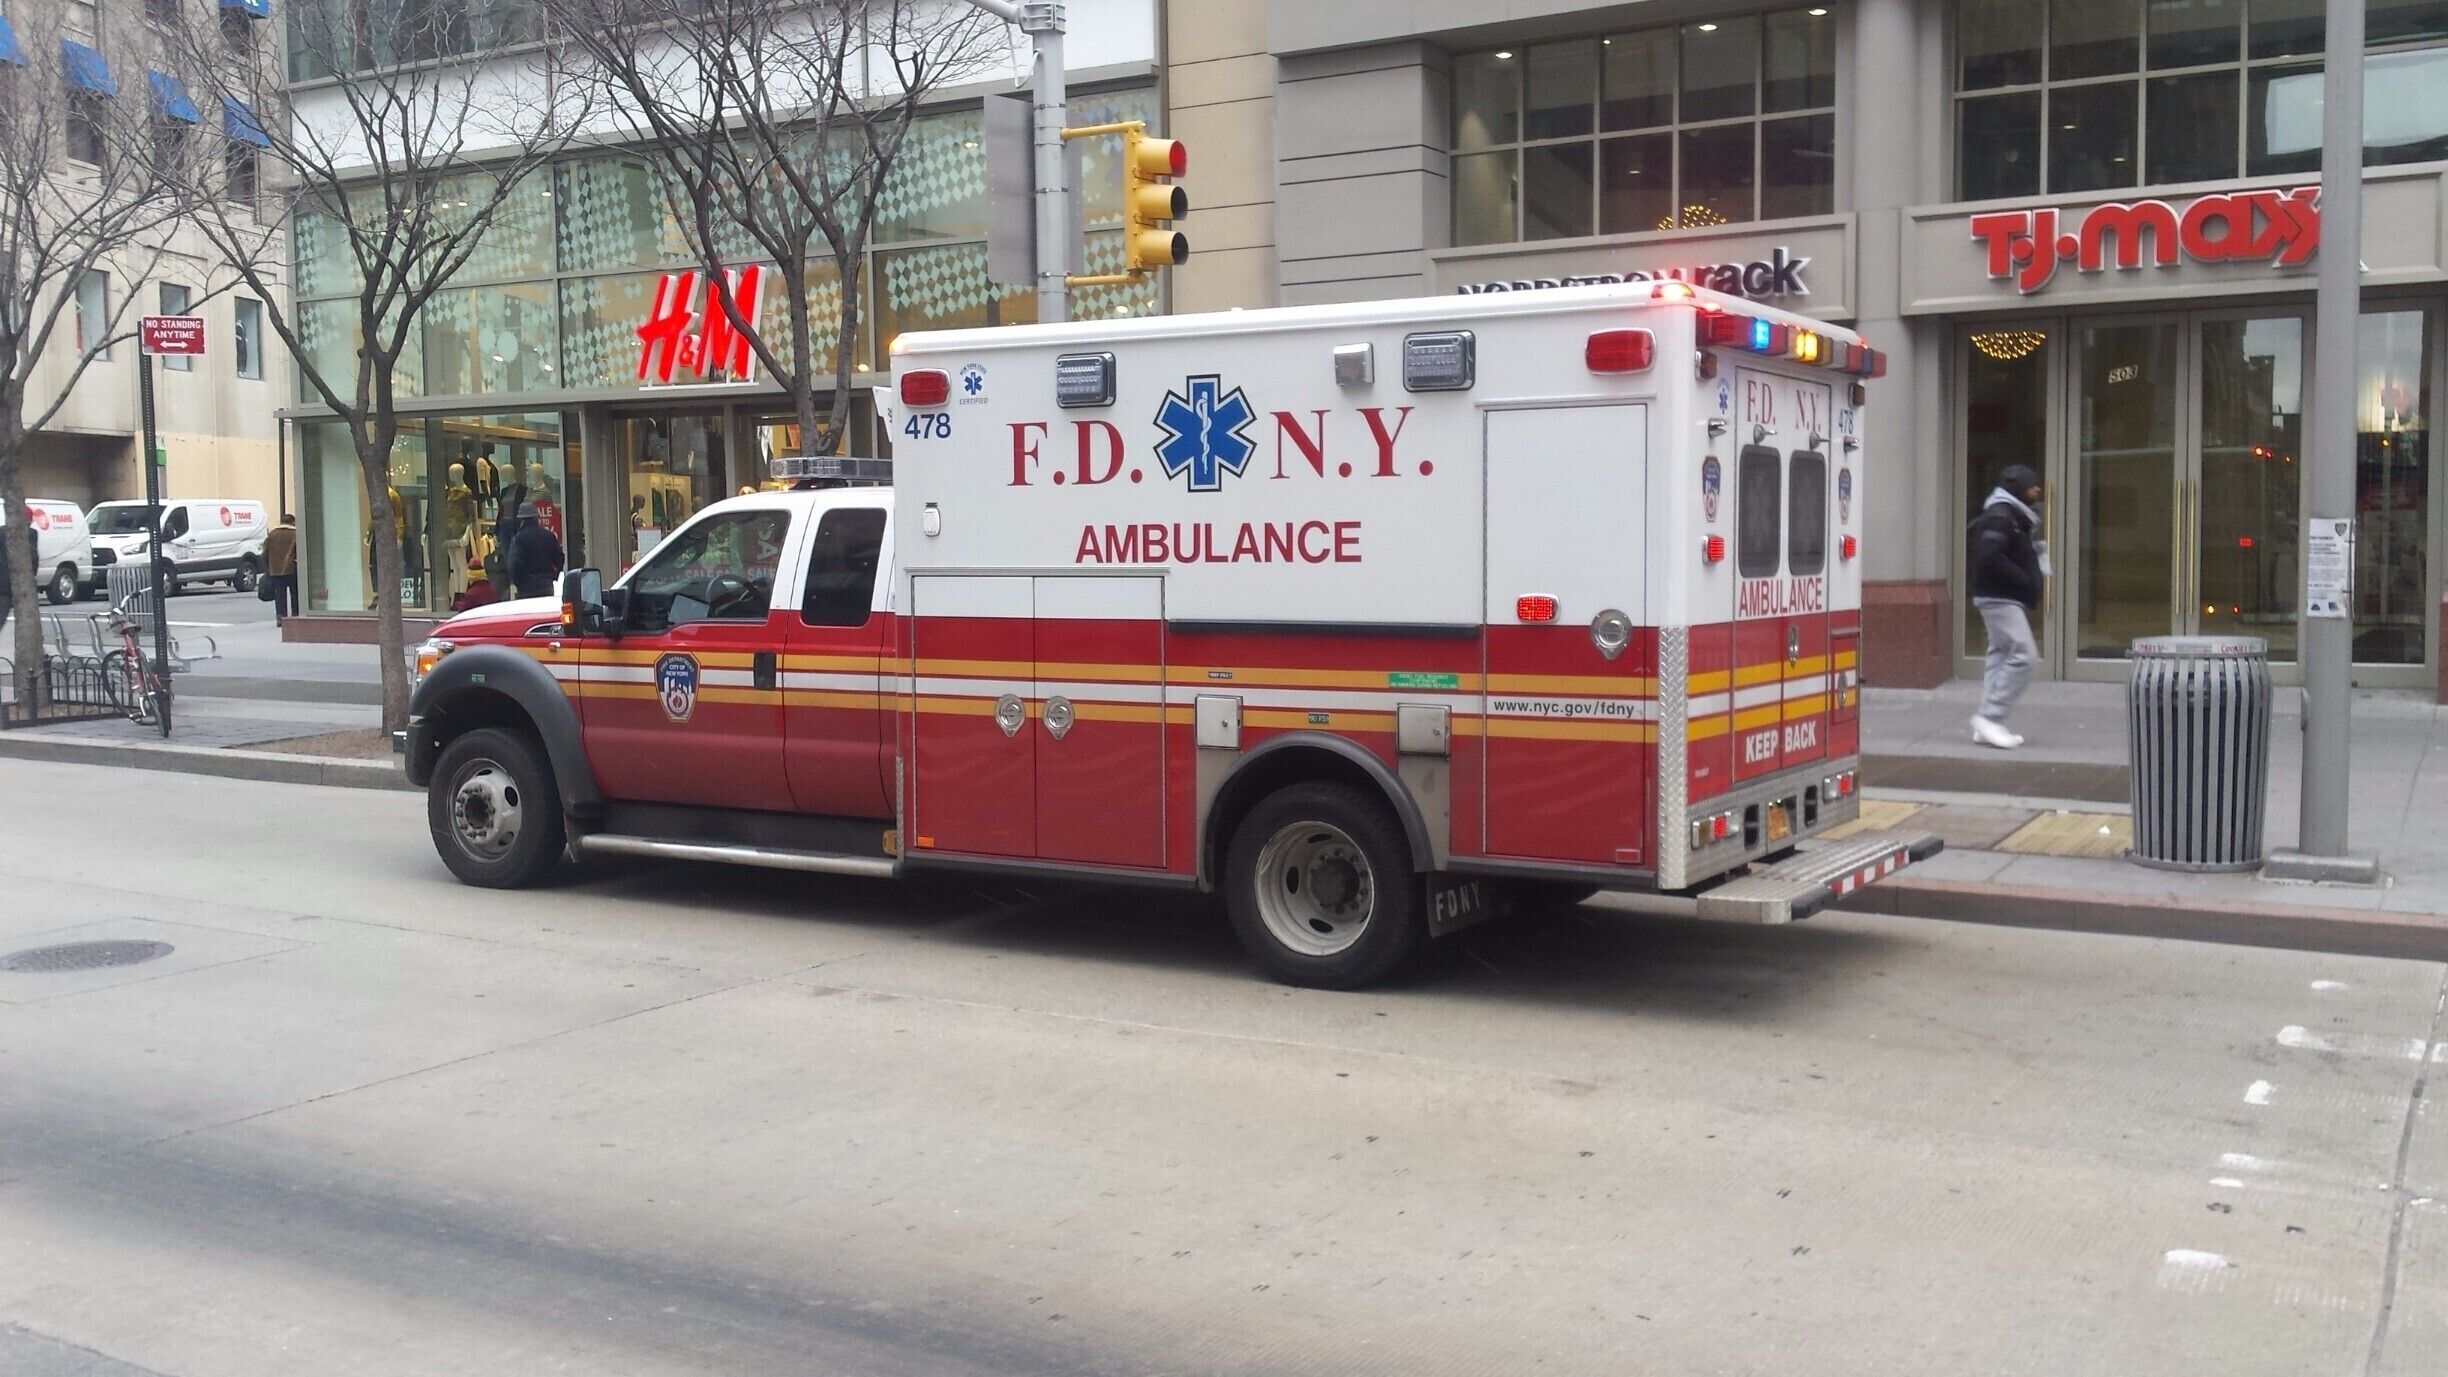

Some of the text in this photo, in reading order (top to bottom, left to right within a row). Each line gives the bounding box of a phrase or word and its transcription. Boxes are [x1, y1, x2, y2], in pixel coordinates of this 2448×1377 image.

[146, 320, 201, 329] NO STANDING
[153, 330, 196, 339] ANYTIME
[637, 265, 763, 382] H&M
[960, 397, 989, 405] CERTIFIED
[1747, 379, 1776, 425] F.D.
[905, 413, 951, 439] 478
[1006, 407, 1434, 486] F.D. N.Y.
[234, 512, 252, 520] TRANE
[1075, 520, 1362, 563] AMBULANCE
[1739, 577, 1822, 617] AMBULANCE
[1494, 701, 1634, 718] www.nyc.gov/fdny
[1746, 721, 1816, 764] KEEP BACK
[1436, 880, 1480, 922] FDNY
